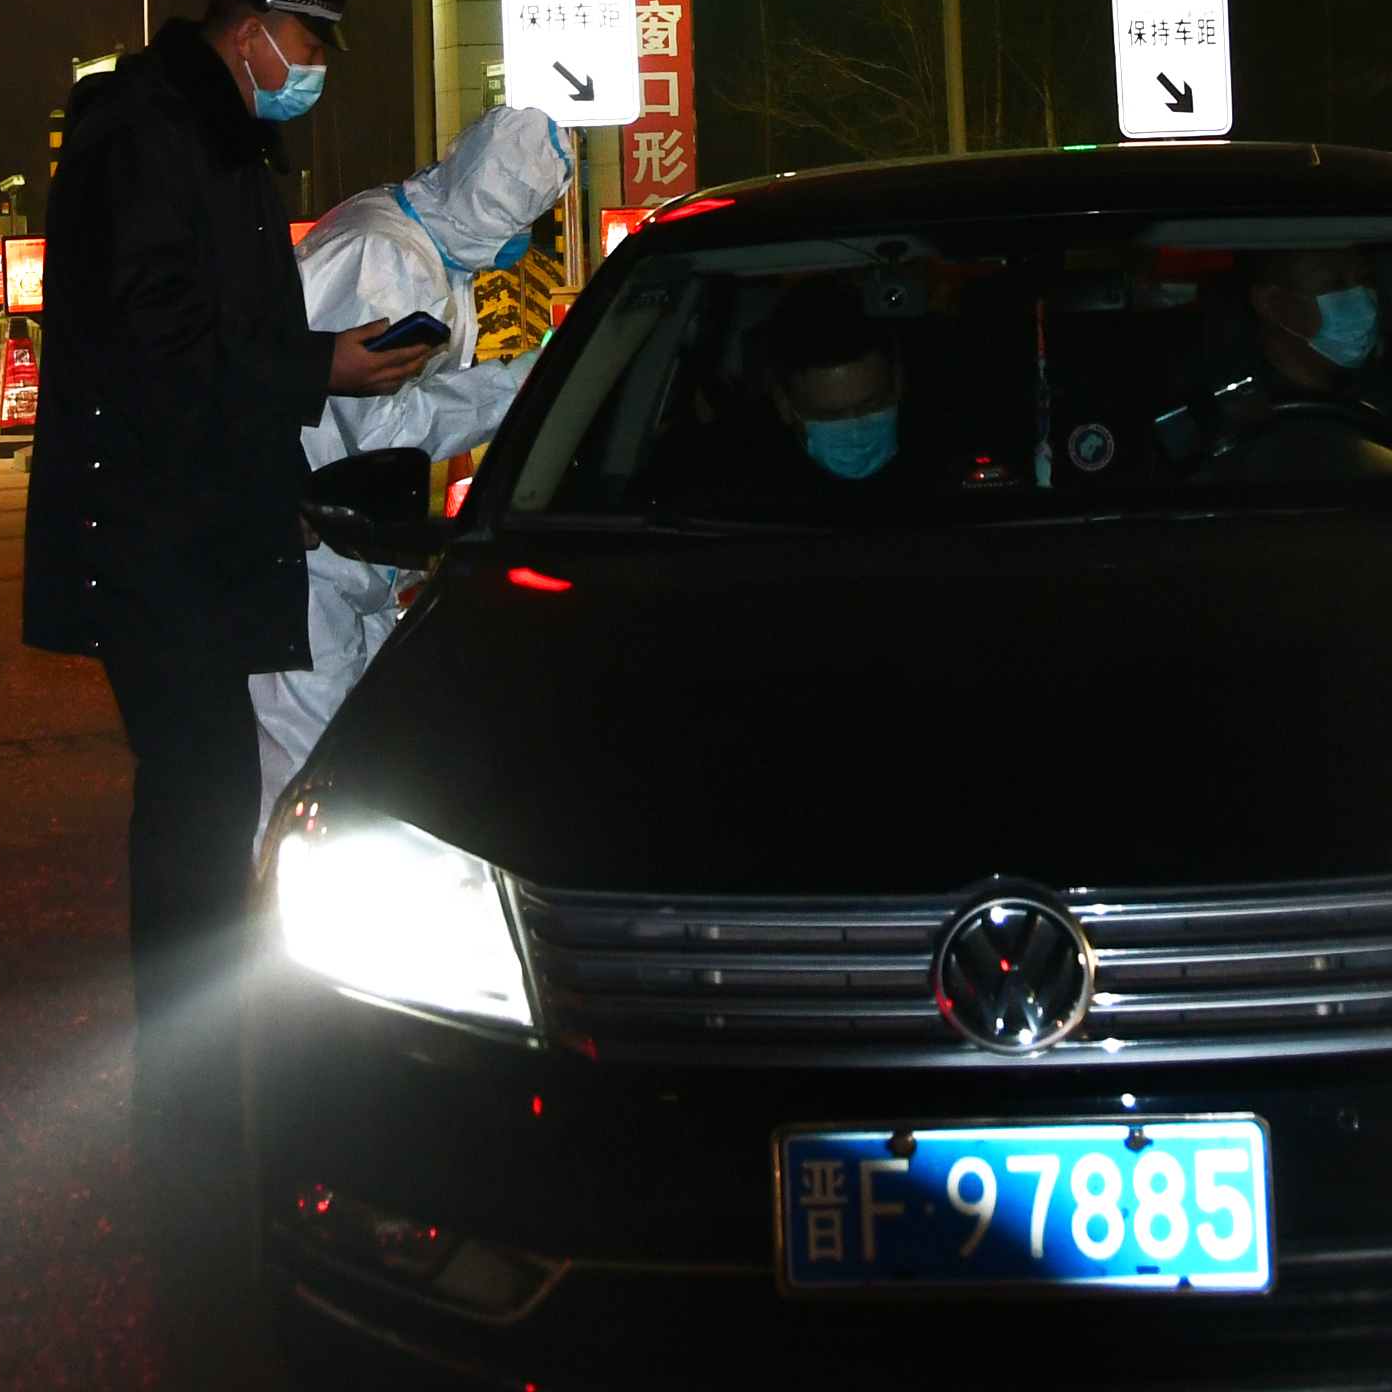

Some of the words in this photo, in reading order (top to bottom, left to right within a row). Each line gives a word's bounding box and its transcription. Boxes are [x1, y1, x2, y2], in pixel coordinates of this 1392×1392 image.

[519, 2, 621, 31] 保持车距
[1127, 18, 1217, 47] 保持车距
